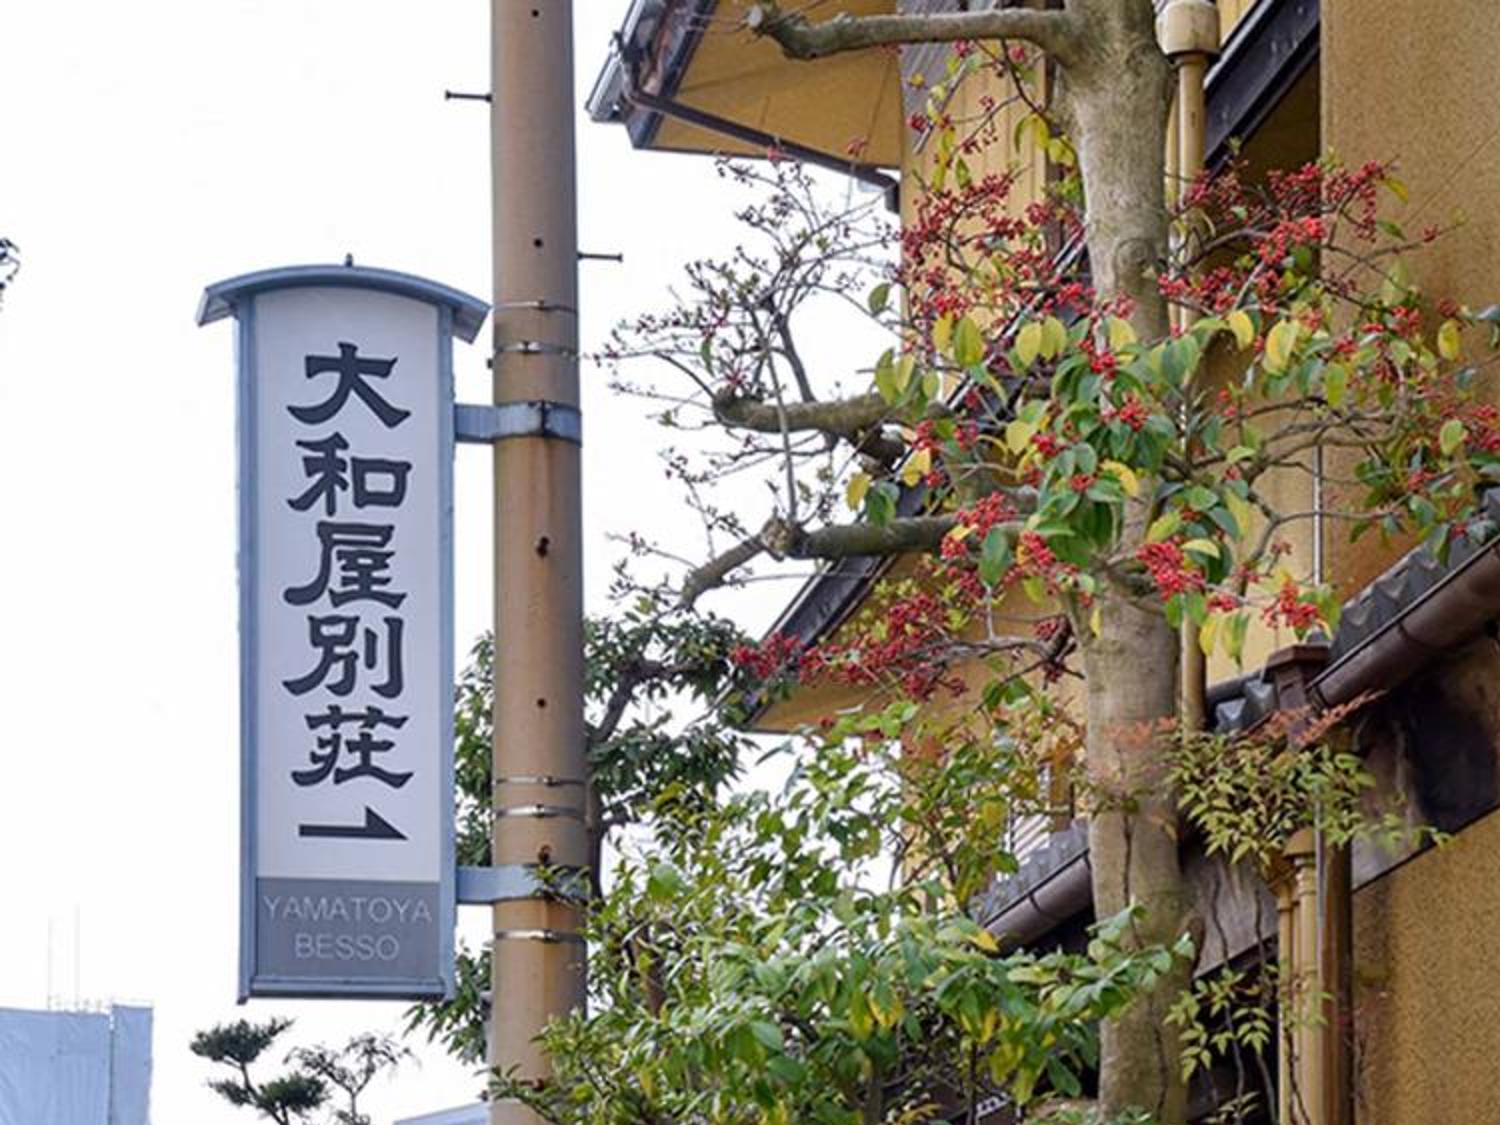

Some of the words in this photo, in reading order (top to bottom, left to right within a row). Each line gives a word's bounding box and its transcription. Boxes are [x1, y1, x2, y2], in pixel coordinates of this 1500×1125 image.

[283, 342, 413, 788] 大和屋別荘
[263, 896, 432, 923] YAMATOYA
[294, 933, 400, 960] BESSO
